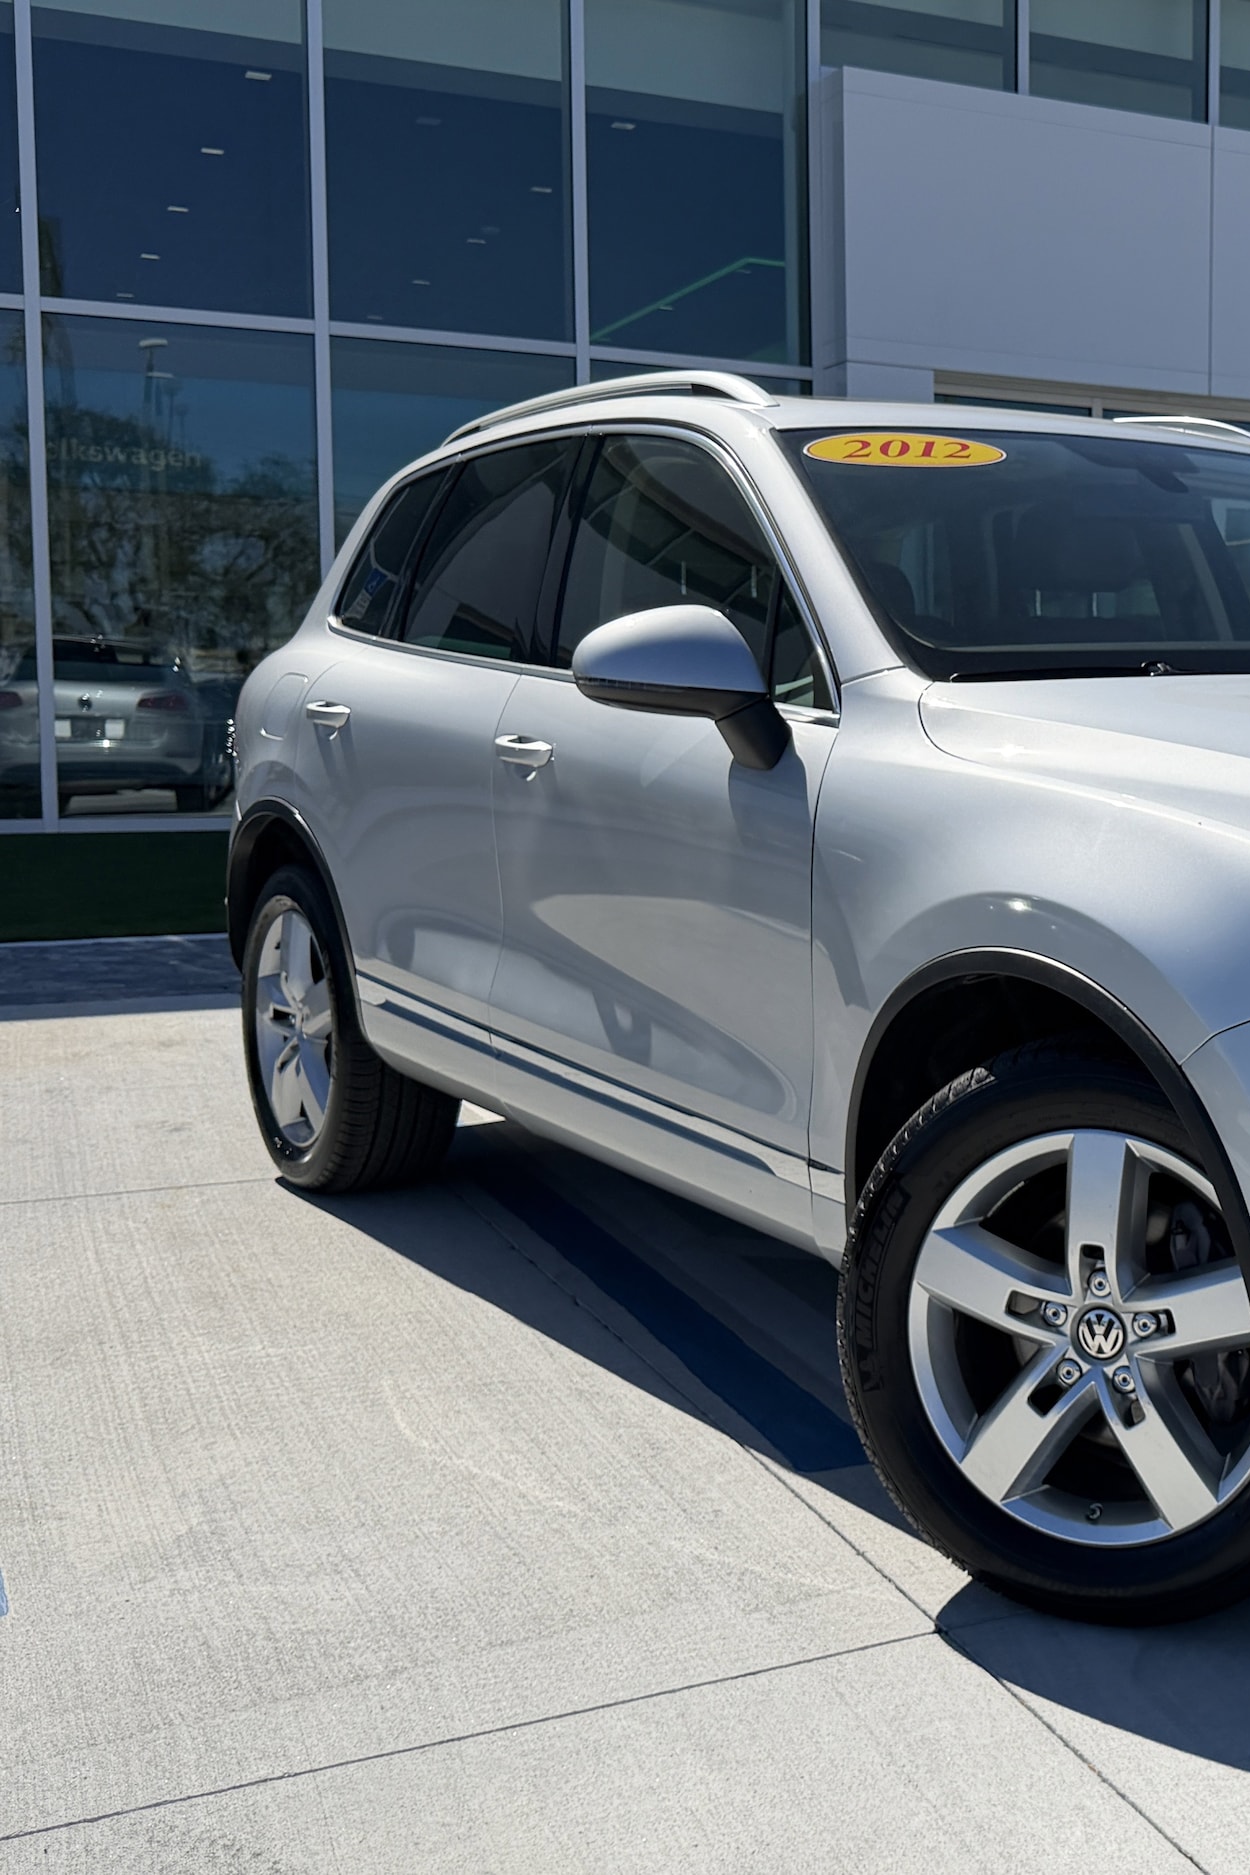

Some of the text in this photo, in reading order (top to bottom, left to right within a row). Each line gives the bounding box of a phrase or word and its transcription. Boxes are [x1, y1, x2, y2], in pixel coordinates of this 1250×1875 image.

[46, 436, 201, 472] olkswagen
[842, 439, 971, 459] 2012
[855, 1180, 908, 1349] MICHELIN
